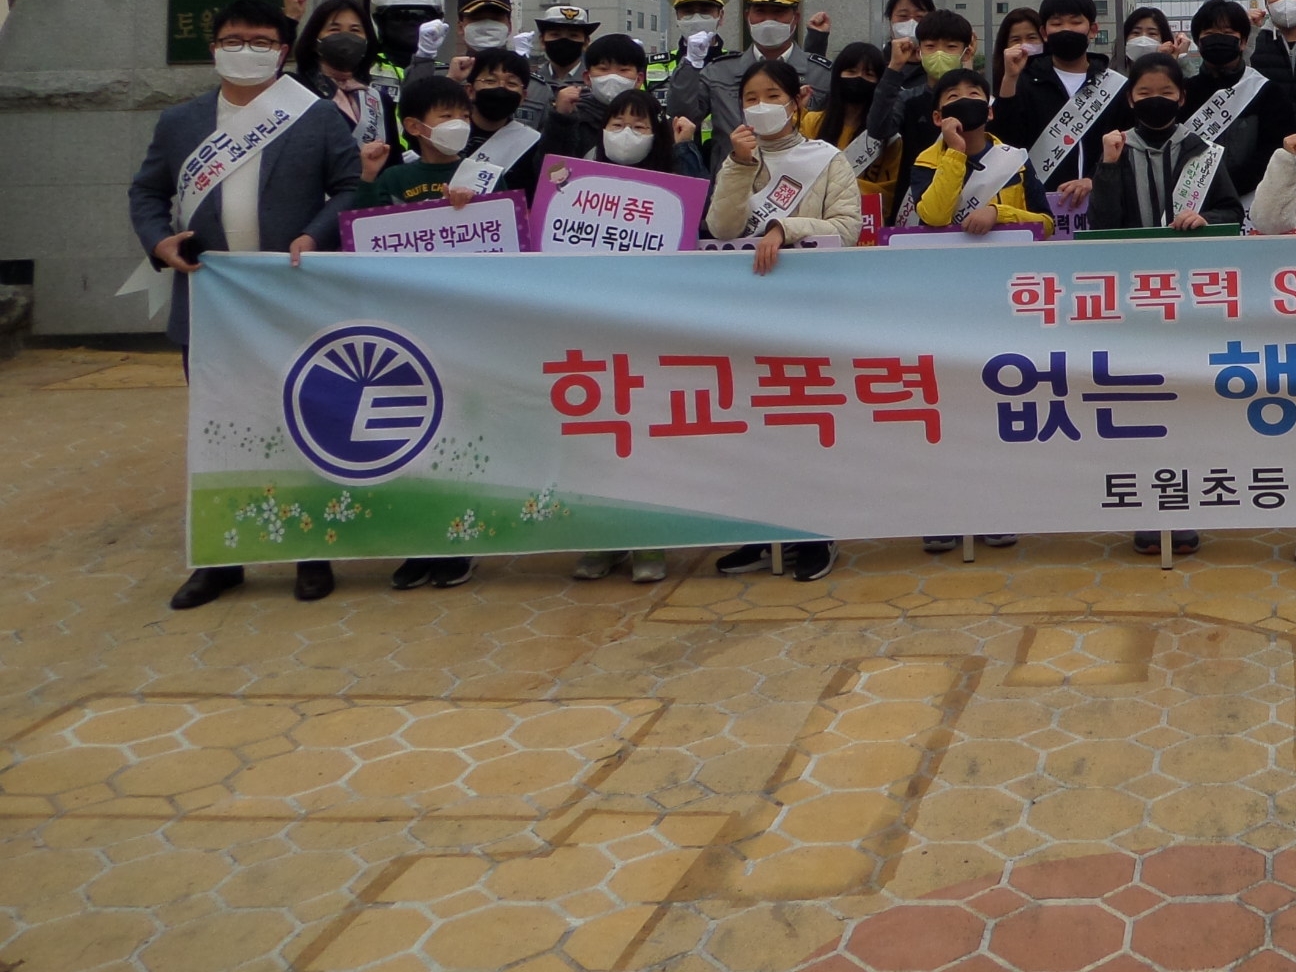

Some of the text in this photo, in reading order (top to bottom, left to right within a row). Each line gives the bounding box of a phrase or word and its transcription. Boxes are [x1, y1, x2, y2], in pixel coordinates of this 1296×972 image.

[227, 109, 290, 163] 학교폭력
[1042, 88, 1111, 172] 아름다운 세상
[1048, 111, 1074, 139] 없는
[572, 190, 655, 224] 사이버 중독
[371, 219, 502, 254] 친구사랑 학교사랑
[552, 217, 665, 252] 인생의 독입니다
[1009, 268, 1240, 326] 학교폭력
[543, 347, 943, 458] 학교폭력
[981, 350, 1179, 445] 없는
